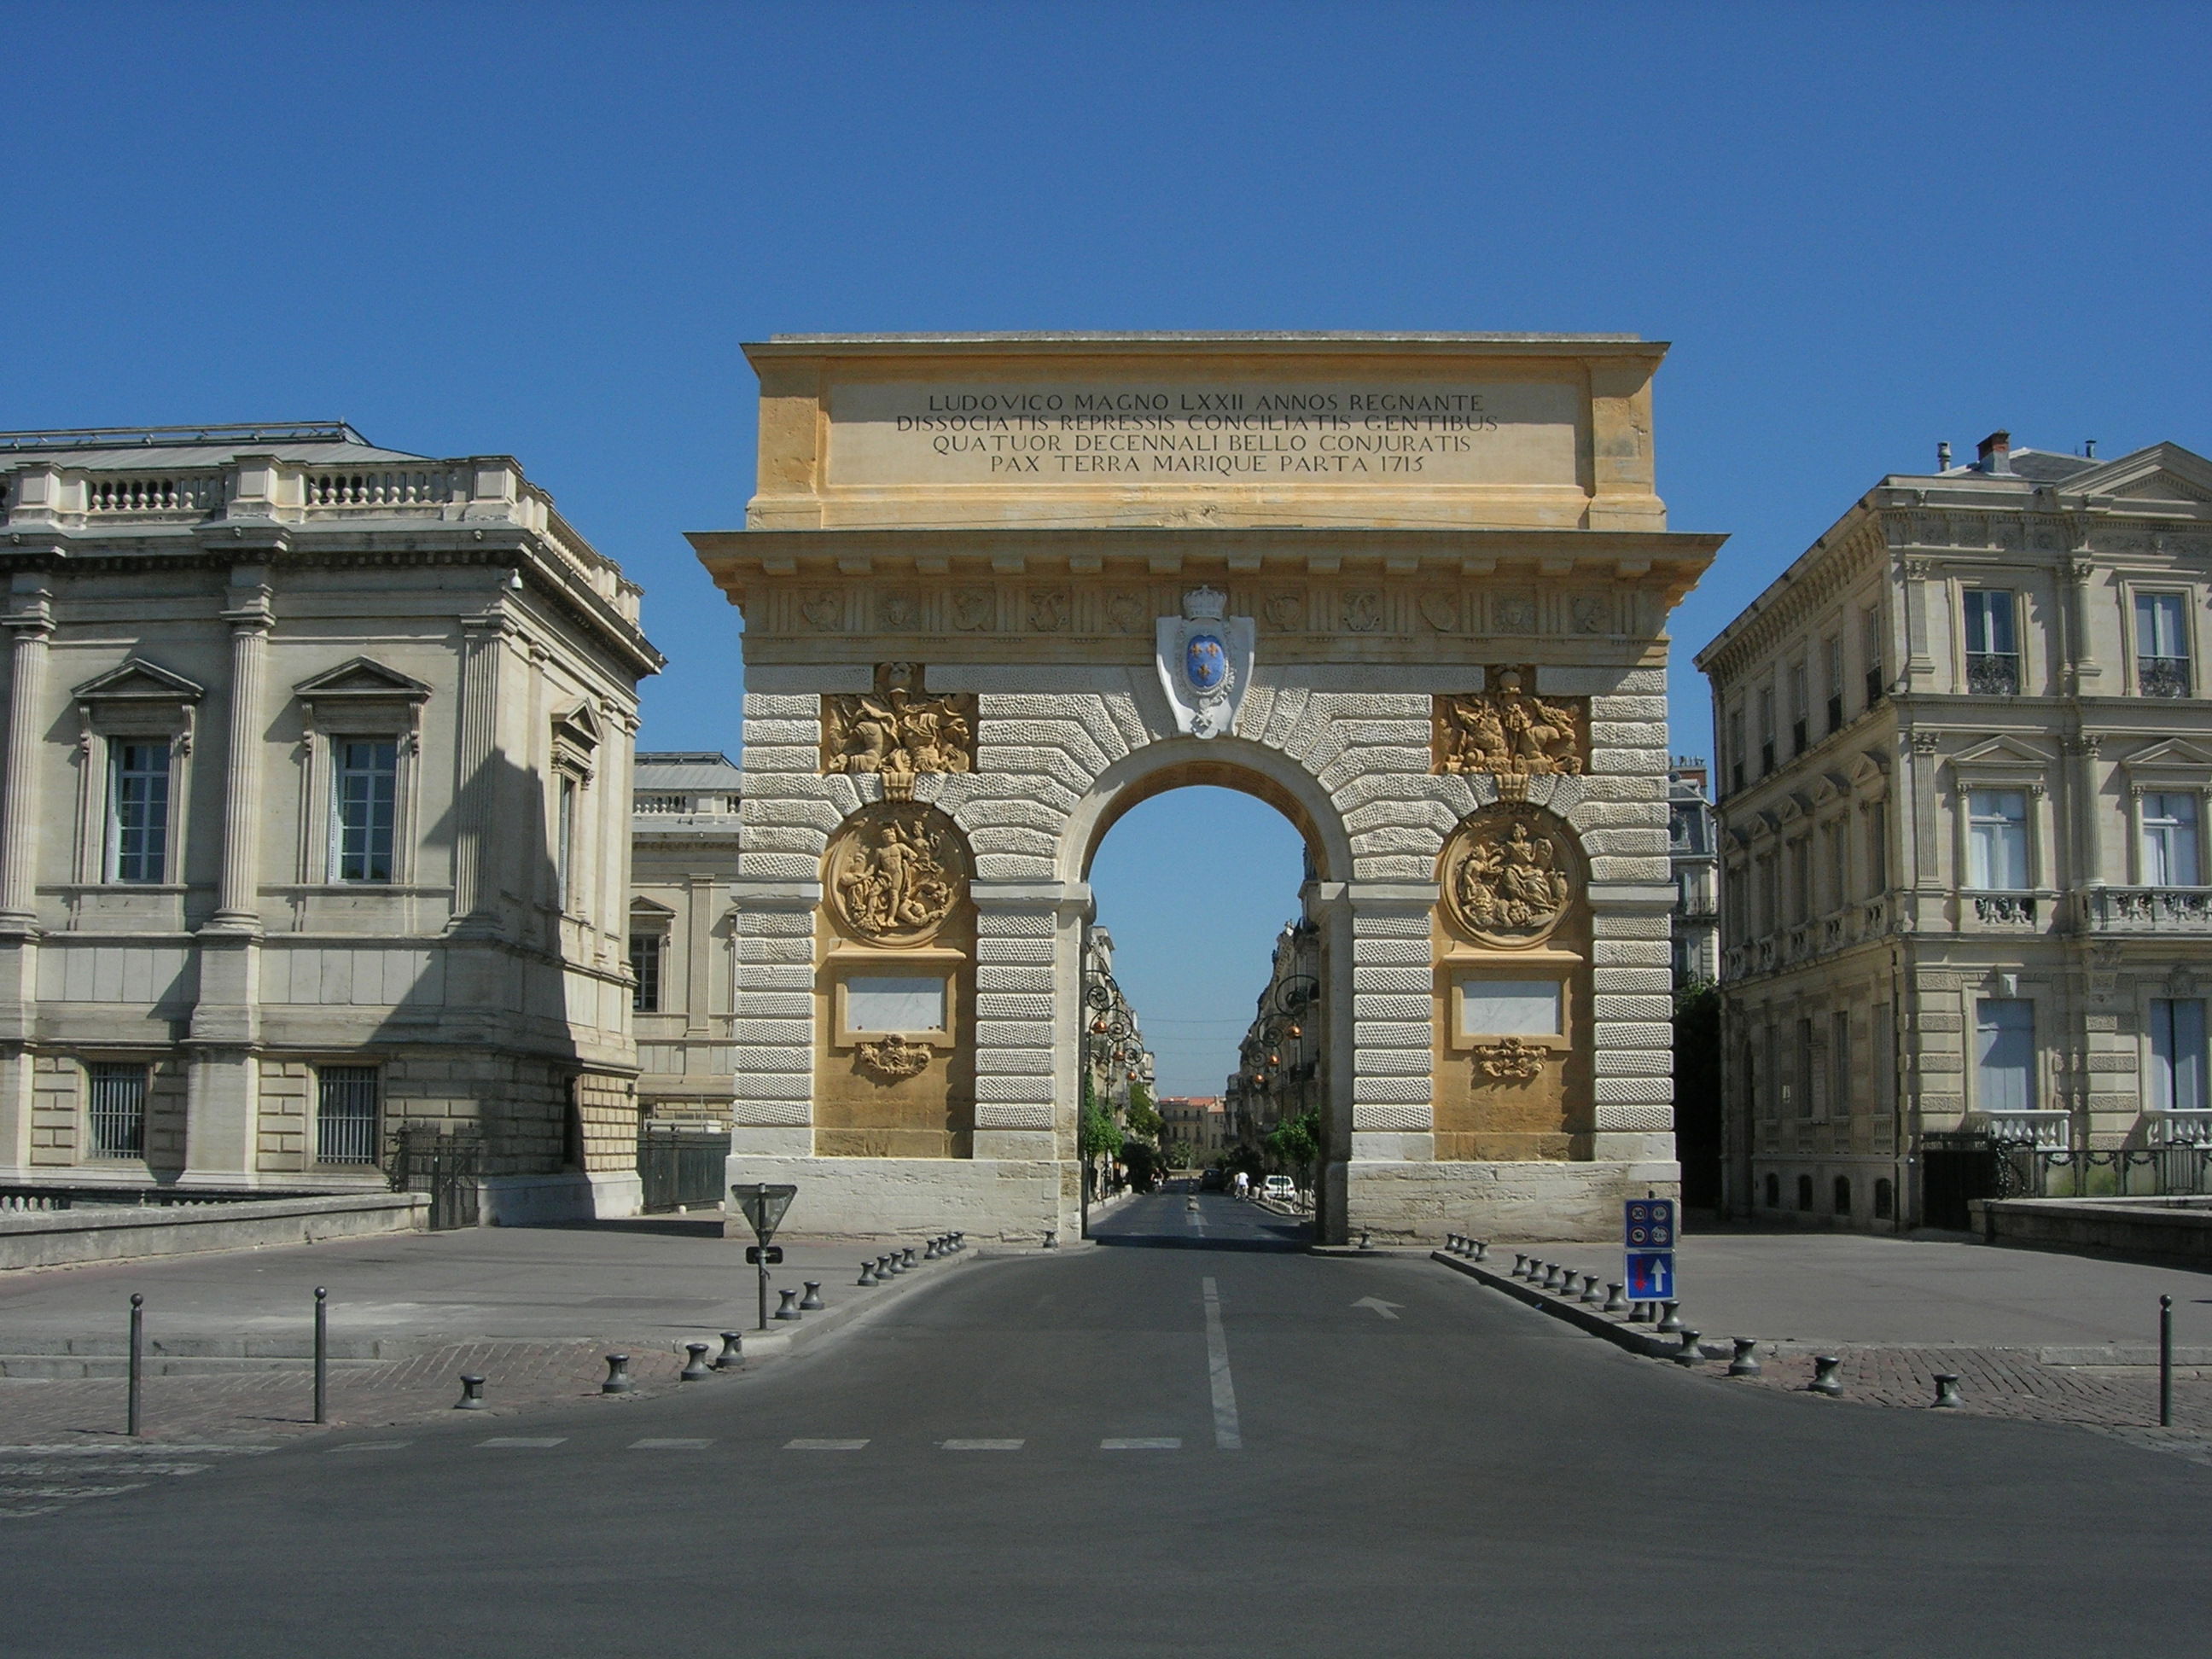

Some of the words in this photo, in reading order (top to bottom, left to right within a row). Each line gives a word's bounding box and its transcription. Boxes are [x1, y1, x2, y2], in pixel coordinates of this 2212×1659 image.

[929, 394, 1063, 411] LUDOVICO
[1074, 394, 1169, 411] MAGNO
[1181, 394, 1243, 411] LXXII
[1255, 394, 1338, 411] ANNOS
[1350, 394, 1484, 411] REGNANTE
[897, 415, 1049, 432] DISSOCIATIS
[1061, 415, 1175, 432] REPRESSIS
[1188, 415, 1351, 431] CONCILIATIS
[1365, 415, 1498, 432] GENTIBUS
[933, 435, 1062, 456] QUATUOR
[1075, 435, 1218, 451] DECENNALI
[1230, 435, 1307, 451] BELLO
[1319, 435, 1471, 454] CONJURATIS
[992, 456, 1039, 472] PAX
[1054, 456, 1140, 472] TERRA
[1153, 456, 1267, 477] MARIQUE
[1280, 456, 1368, 472] PARTA
[1381, 456, 1425, 472] 1715
